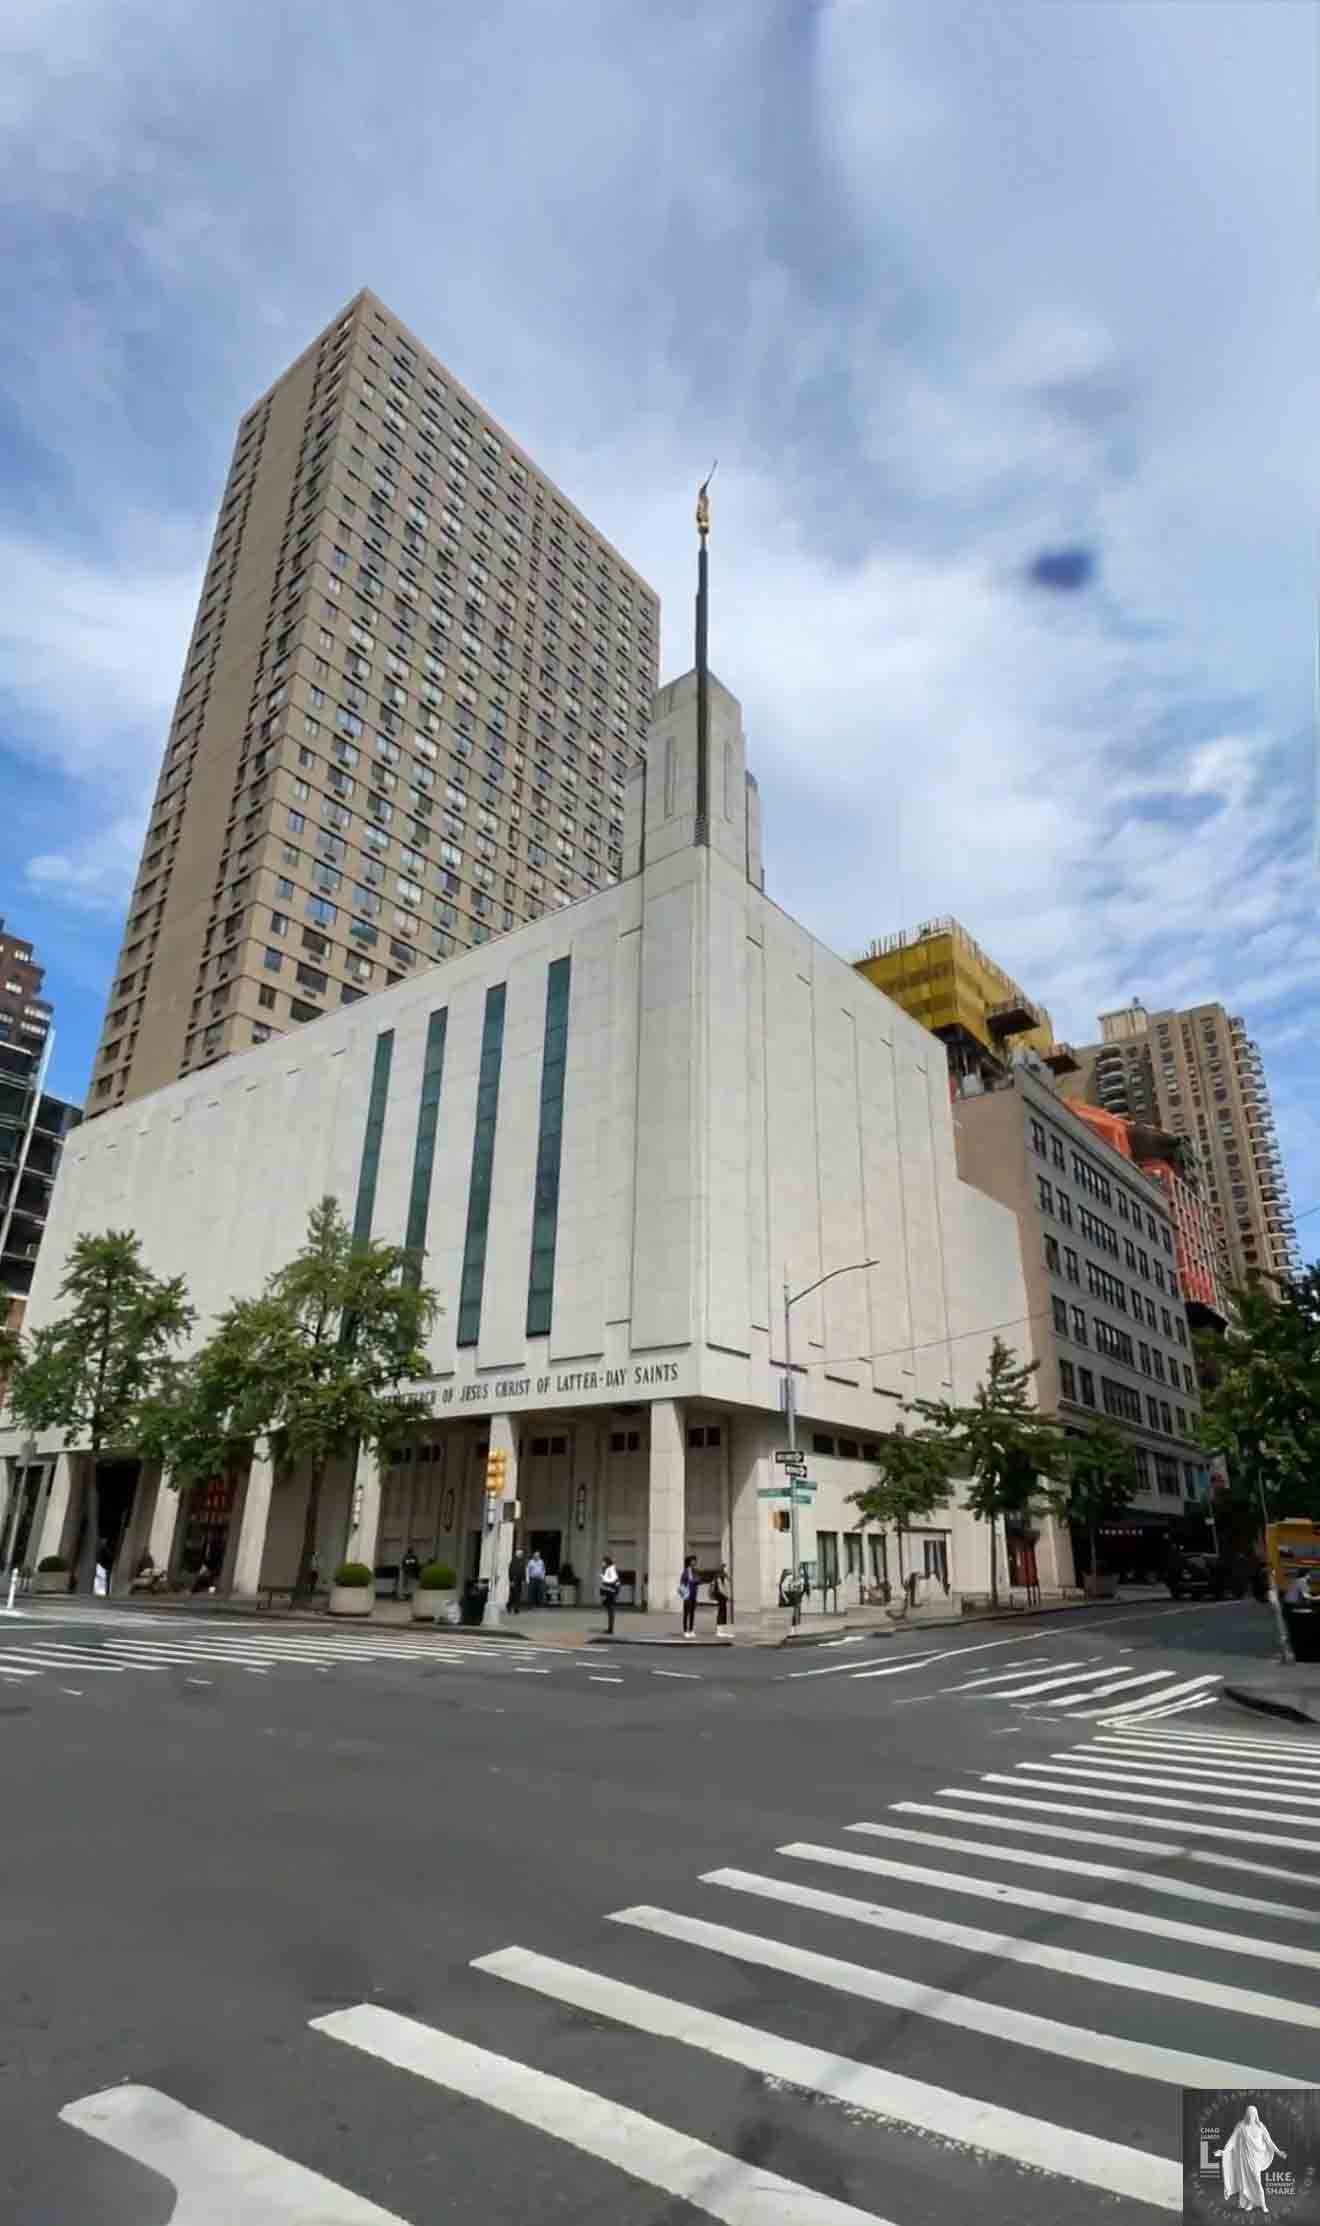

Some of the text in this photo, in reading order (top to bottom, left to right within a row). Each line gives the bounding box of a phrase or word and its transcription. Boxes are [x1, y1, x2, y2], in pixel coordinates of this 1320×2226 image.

[461, 1384, 488, 1402] JESUS
[496, 1379, 530, 1397] CHRIST
[537, 1377, 551, 1394] OF
[557, 1370, 625, 1391] LATTER-DAY
[635, 1363, 679, 1384] SAINTS
